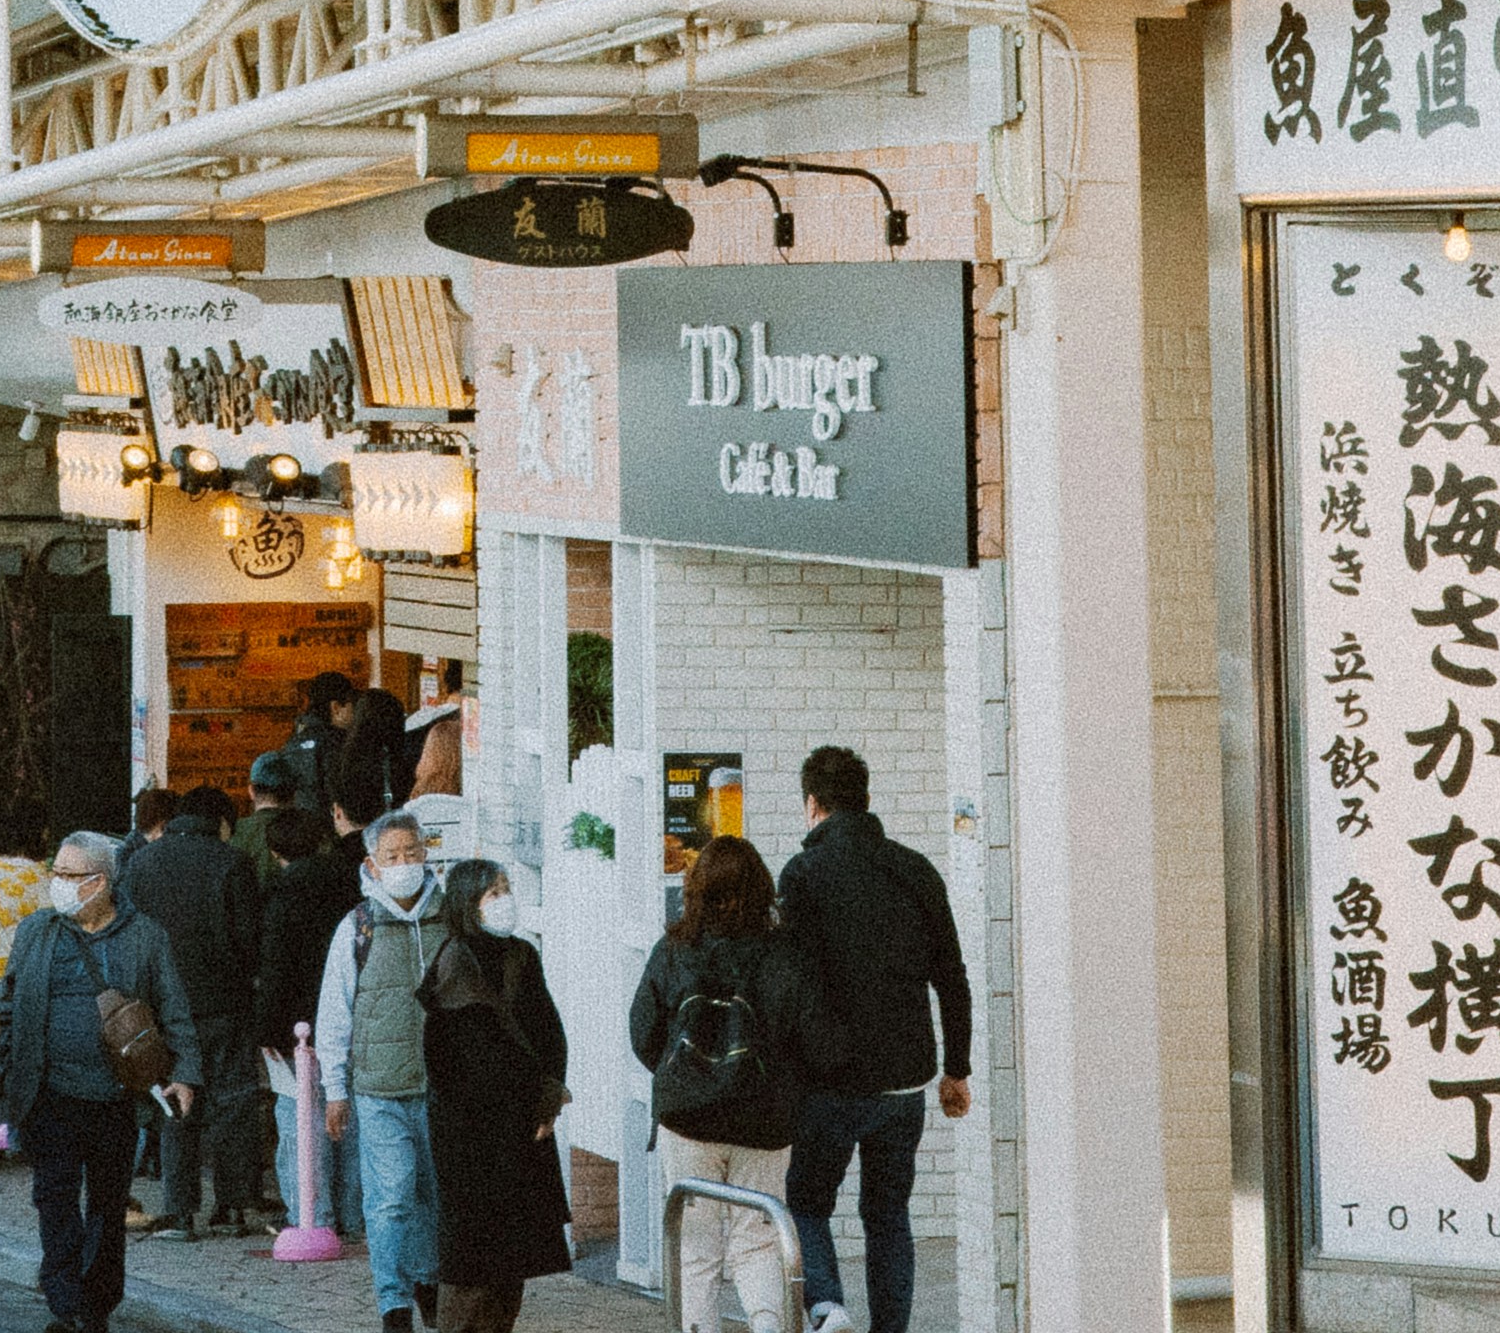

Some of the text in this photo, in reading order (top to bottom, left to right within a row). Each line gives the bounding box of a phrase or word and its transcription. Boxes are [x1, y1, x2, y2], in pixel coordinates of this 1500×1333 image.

[490, 138, 634, 167] Atami Ginza
[93, 238, 213, 263] Atami Ginza
[518, 244, 602, 259] ゲストハウス
[680, 320, 879, 441] TB burger
[770, 451, 794, 497] &
[796, 446, 840, 501] Bar
[1318, 418, 1393, 1076] 浜焼き 立ち飲み 魚酒場
[667, 768, 701, 782] CRAFT
